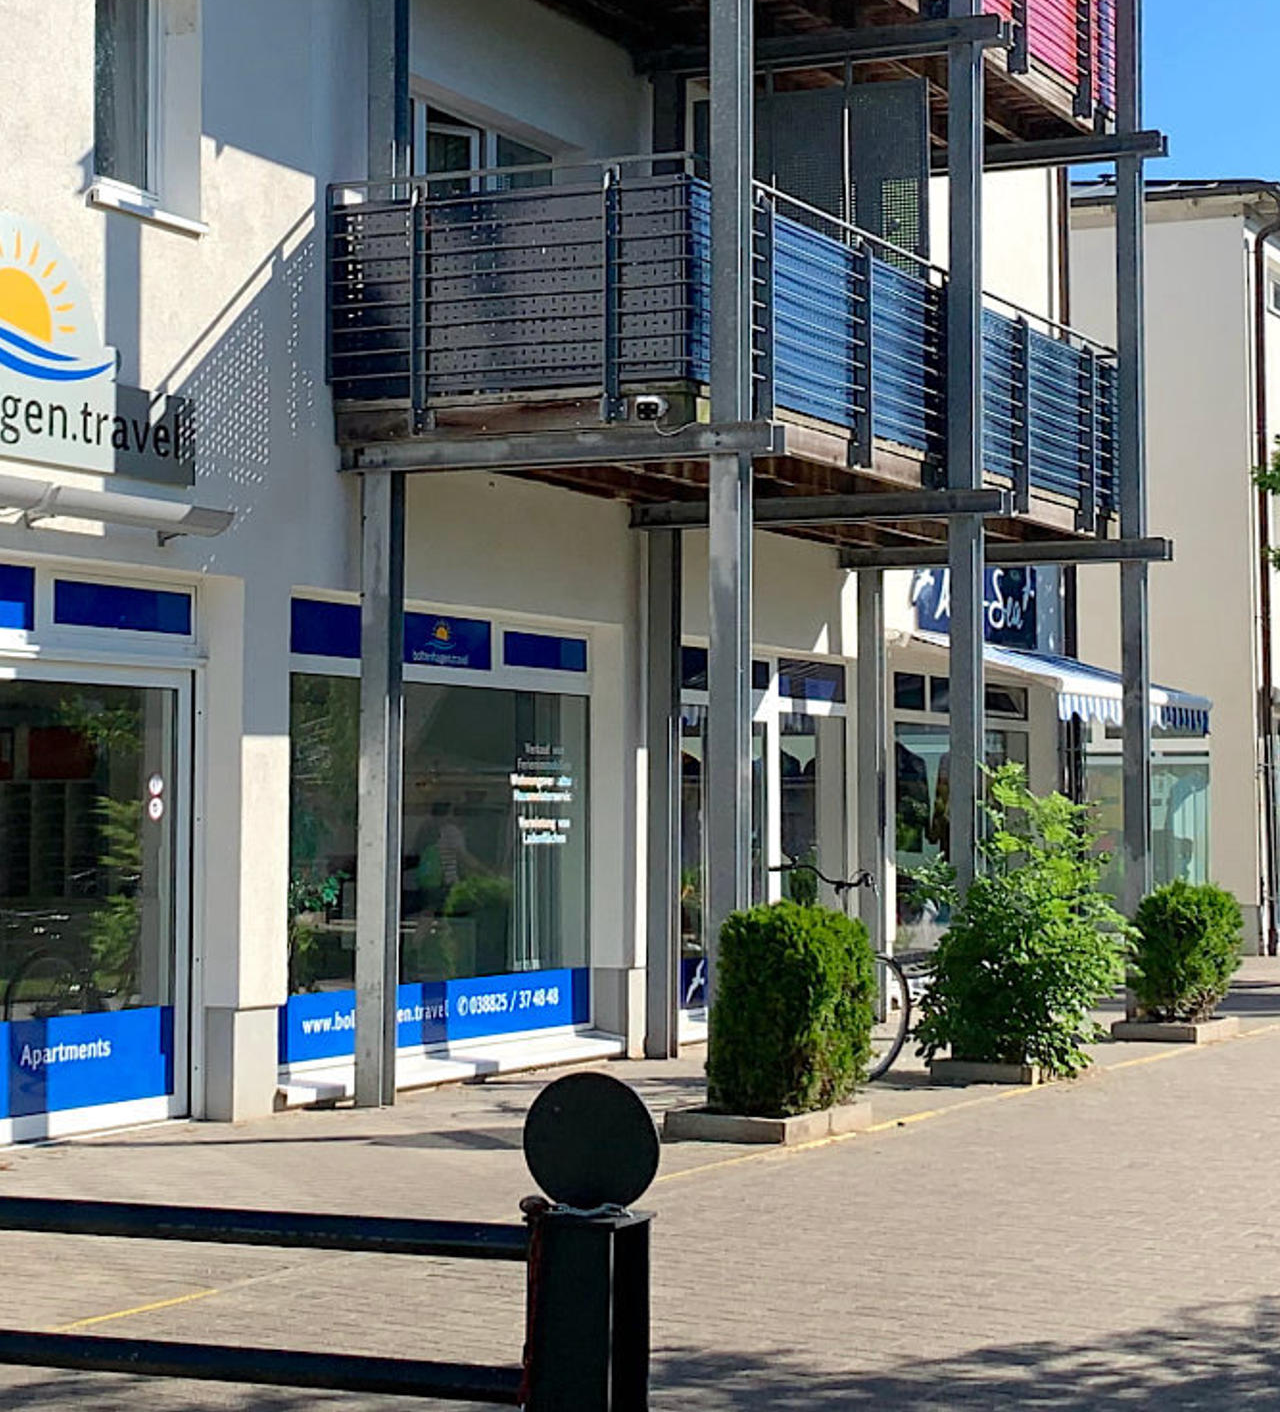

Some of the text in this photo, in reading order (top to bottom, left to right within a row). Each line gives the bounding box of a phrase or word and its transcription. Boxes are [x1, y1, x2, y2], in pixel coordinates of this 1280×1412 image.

[469, 992, 508, 1015] 038825
[519, 990, 532, 1009] 37
[532, 988, 545, 1007] 48
[546, 986, 559, 1006] 48
[20, 1037, 112, 1070] Apartments
